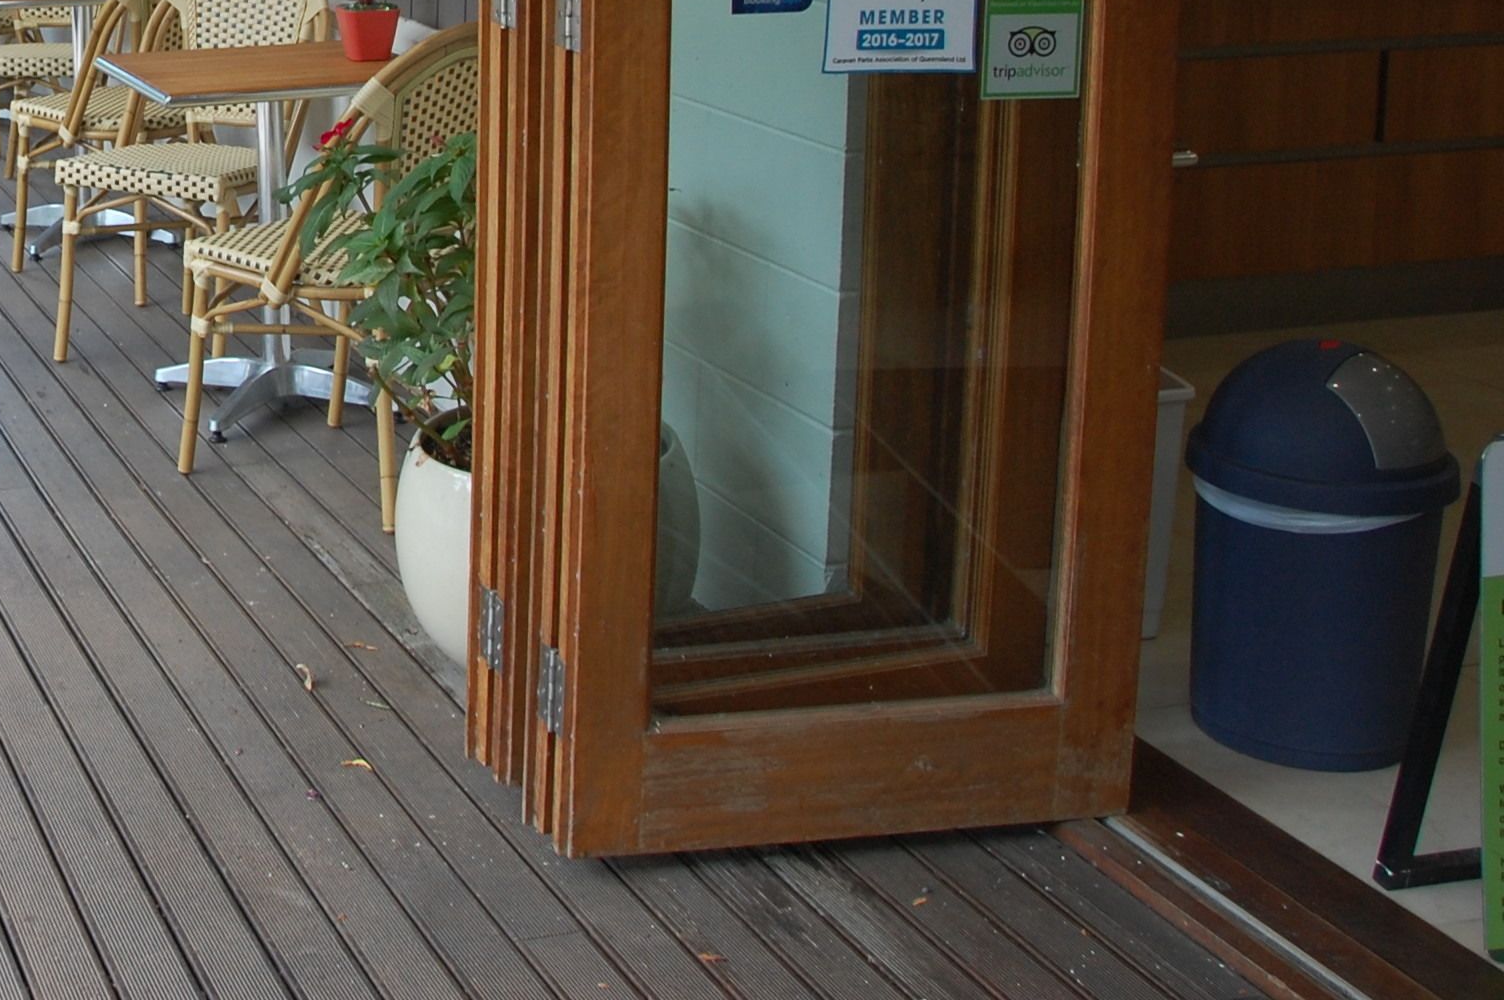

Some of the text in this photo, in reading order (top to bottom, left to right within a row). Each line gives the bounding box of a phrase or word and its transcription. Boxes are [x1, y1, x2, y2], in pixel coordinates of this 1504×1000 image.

[859, 9, 945, 25] MEMBER
[919, 55, 955, 63] Queensland
[993, 65, 1066, 80] tripadvisor
